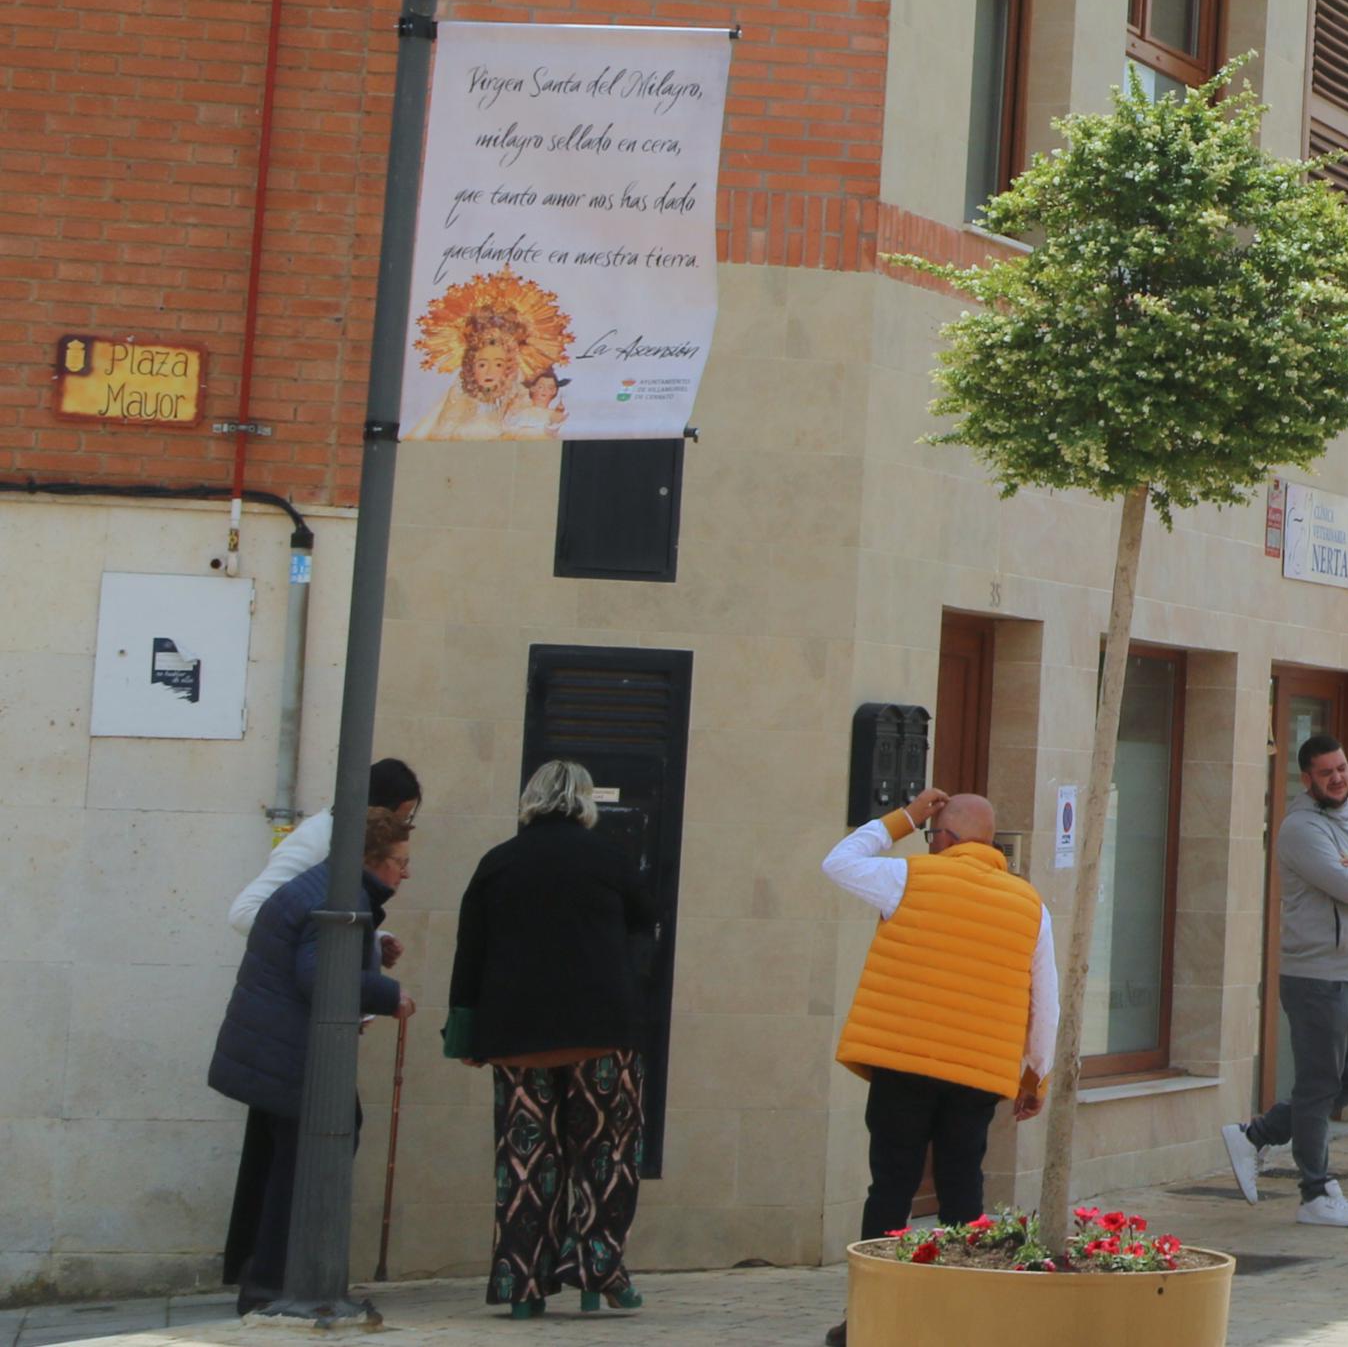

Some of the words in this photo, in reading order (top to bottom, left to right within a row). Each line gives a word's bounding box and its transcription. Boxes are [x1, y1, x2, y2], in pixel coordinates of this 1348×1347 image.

[467, 65, 524, 109] Virgen
[530, 66, 581, 98] Santa
[586, 65, 628, 98] del
[619, 69, 703, 115] Milagro,
[475, 121, 544, 168] milagro
[549, 122, 614, 155] sellado
[617, 138, 637, 154] en
[641, 138, 683, 156] cera,
[445, 188, 485, 229] que
[490, 184, 538, 207] tanto
[542, 192, 587, 207] amor
[588, 193, 614, 211] nos
[618, 180, 649, 212] has
[653, 181, 698, 216] dado
[433, 232, 544, 285] quedándote
[548, 248, 571, 265] en
[573, 246, 640, 268] nuestra
[645, 246, 701, 269] tierra.
[104, 342, 190, 379] Plaza
[576, 329, 618, 360] La
[614, 334, 700, 362] Ascensión
[98, 382, 187, 422] Mayor
[1311, 544, 1348, 578] NERTA
